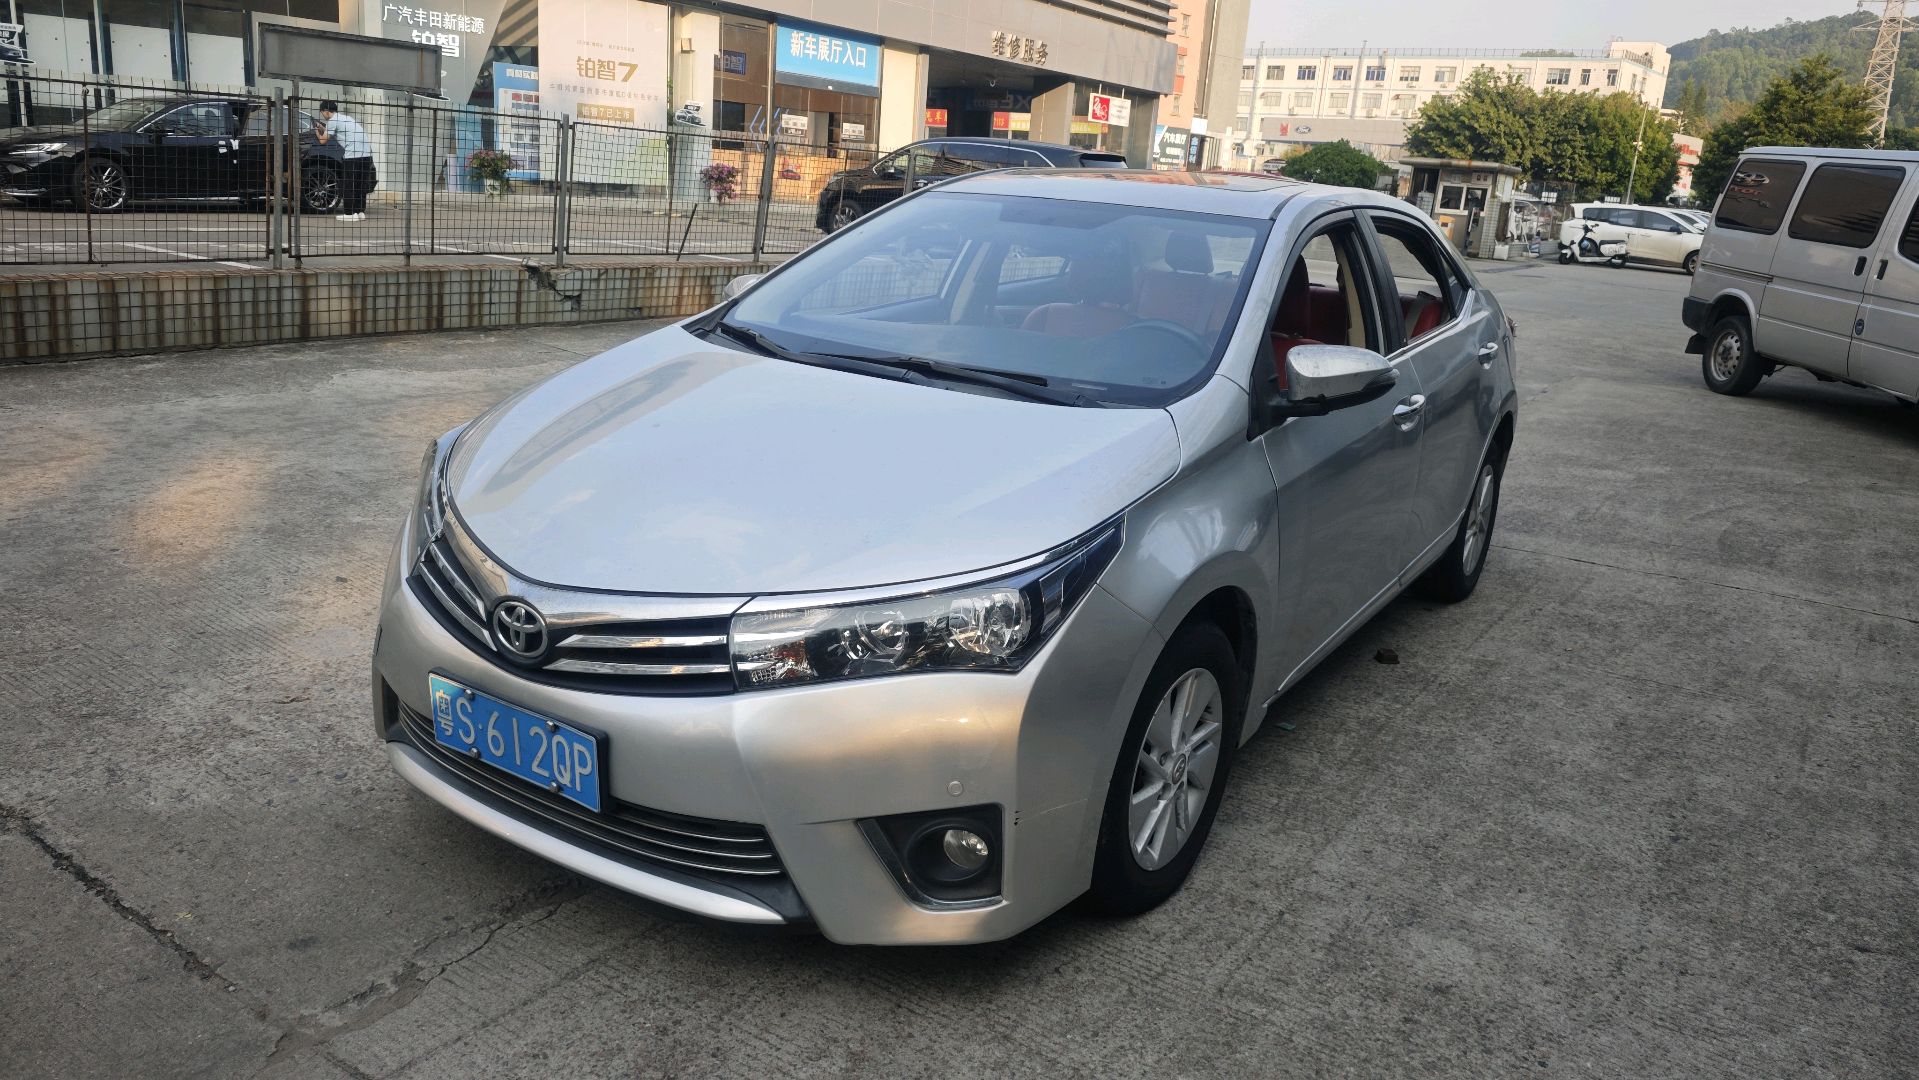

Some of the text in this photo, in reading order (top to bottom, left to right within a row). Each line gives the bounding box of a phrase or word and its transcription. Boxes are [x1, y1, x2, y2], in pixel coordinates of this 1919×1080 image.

[382, 3, 485, 34] 广汽丰田新能源
[790, 30, 867, 68] 新车展厅入口
[991, 30, 1048, 65] 维修服务
[576, 55, 639, 82] 铂智7
[435, 689, 593, 792] 粤S·612QP
